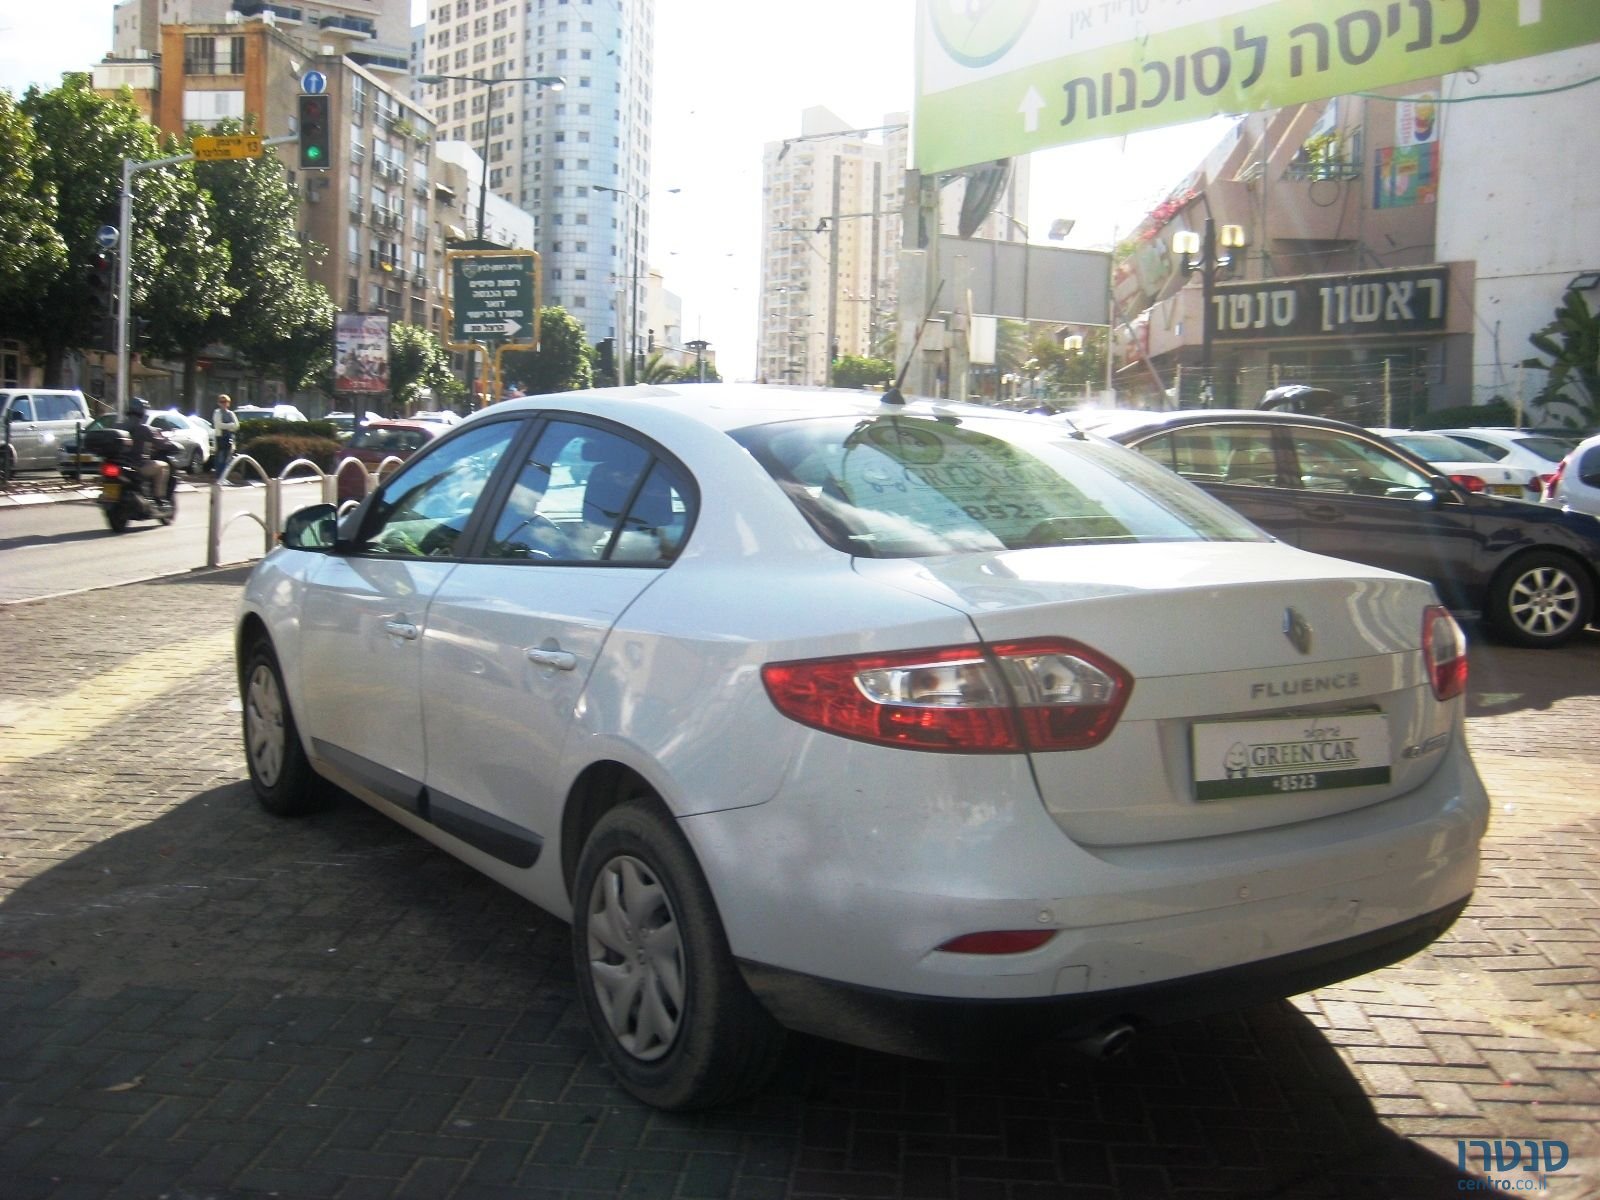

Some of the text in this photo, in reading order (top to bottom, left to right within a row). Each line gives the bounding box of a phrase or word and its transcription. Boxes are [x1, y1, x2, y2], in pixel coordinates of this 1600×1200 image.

[1068, 7, 1093, 40] אין
[1059, 0, 1481, 127] כניסה לסוכנות
[497, 279, 521, 287] רשות
[484, 300, 506, 308] דואר
[497, 309, 524, 318] משרד
[1212, 277, 1443, 332] ראשון סנטר
[1250, 672, 1361, 699] FLUENCE
[1252, 740, 1357, 767] GREEN CAR
